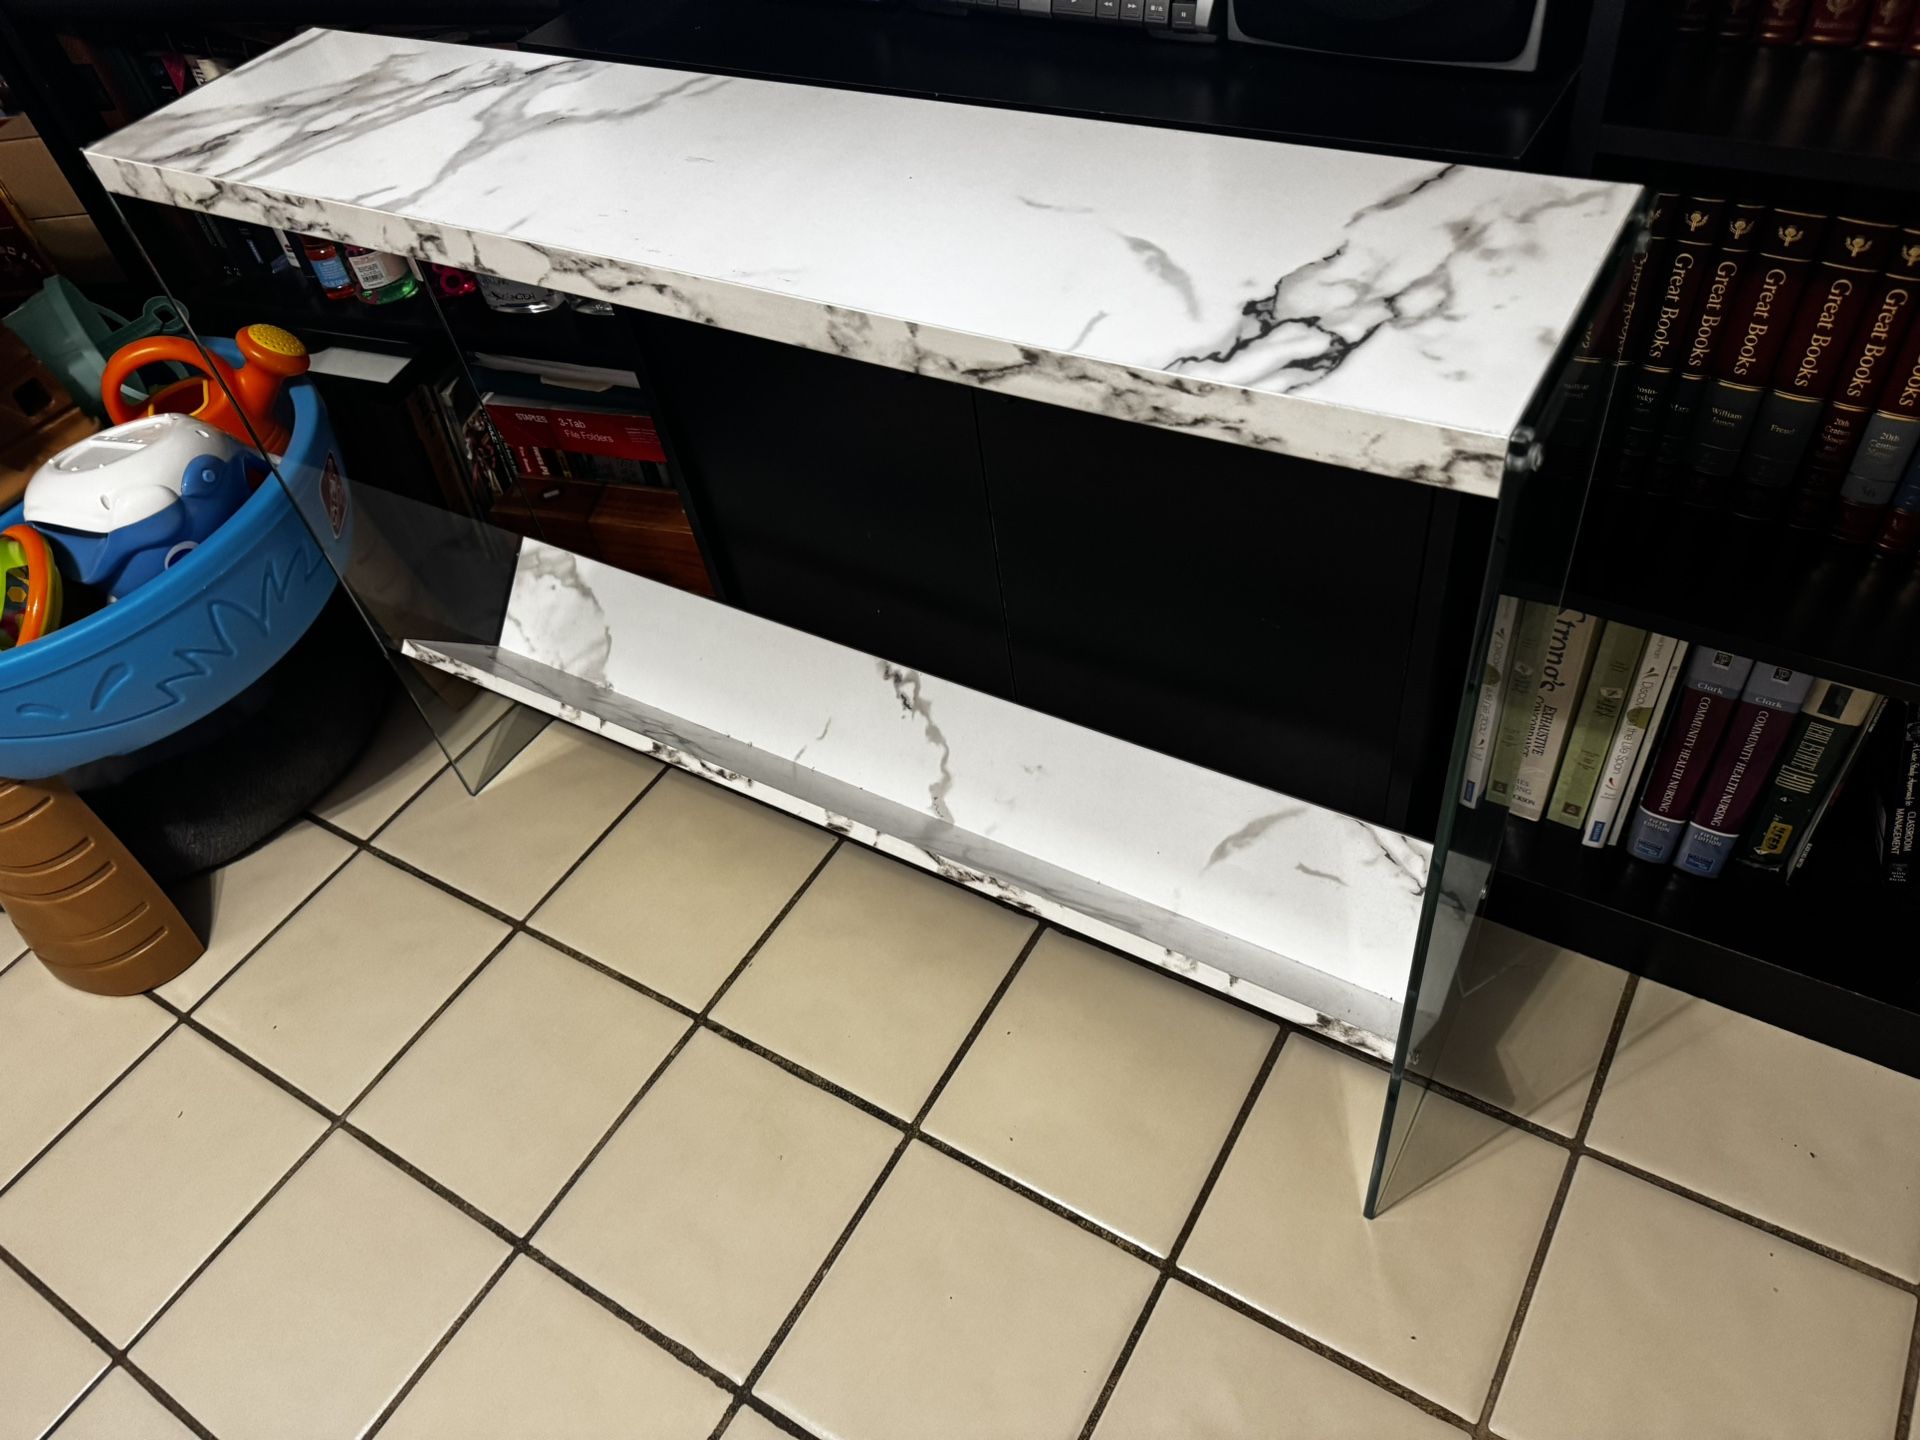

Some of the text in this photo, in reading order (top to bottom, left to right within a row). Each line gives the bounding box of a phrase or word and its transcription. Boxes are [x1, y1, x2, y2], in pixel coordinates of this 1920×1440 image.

[1649, 253, 1694, 358] Great Books
[1688, 261, 1737, 366] Great Books
[1733, 268, 1786, 375] Great Books
[1794, 278, 1852, 387] Great Books
[1846, 288, 1908, 397] Great Books
[1898, 354, 1920, 407] ooks
[514, 412, 549, 424] STAPLES
[558, 417, 586, 429] 3-Tab
[563, 428, 581, 439] File
[580, 431, 615, 444] Folders
[1711, 406, 1742, 420] William
[1770, 424, 1796, 434] Freud
[1697, 682, 1723, 696] Clark
[1755, 696, 1783, 709] Clark
[1532, 704, 1557, 756] EXHAUSTIVE
[1658, 696, 1712, 813] COMMUNITY HEALTH NURSING
[1711, 710, 1769, 828] COMMUNITY HEALTH NURSING
[1774, 721, 1835, 795] REAL ESTATE LAW
[1766, 825, 1787, 850] USED
[1890, 807, 1905, 856] MANAGEMENT
[1903, 810, 1917, 852] CLASSROOM
